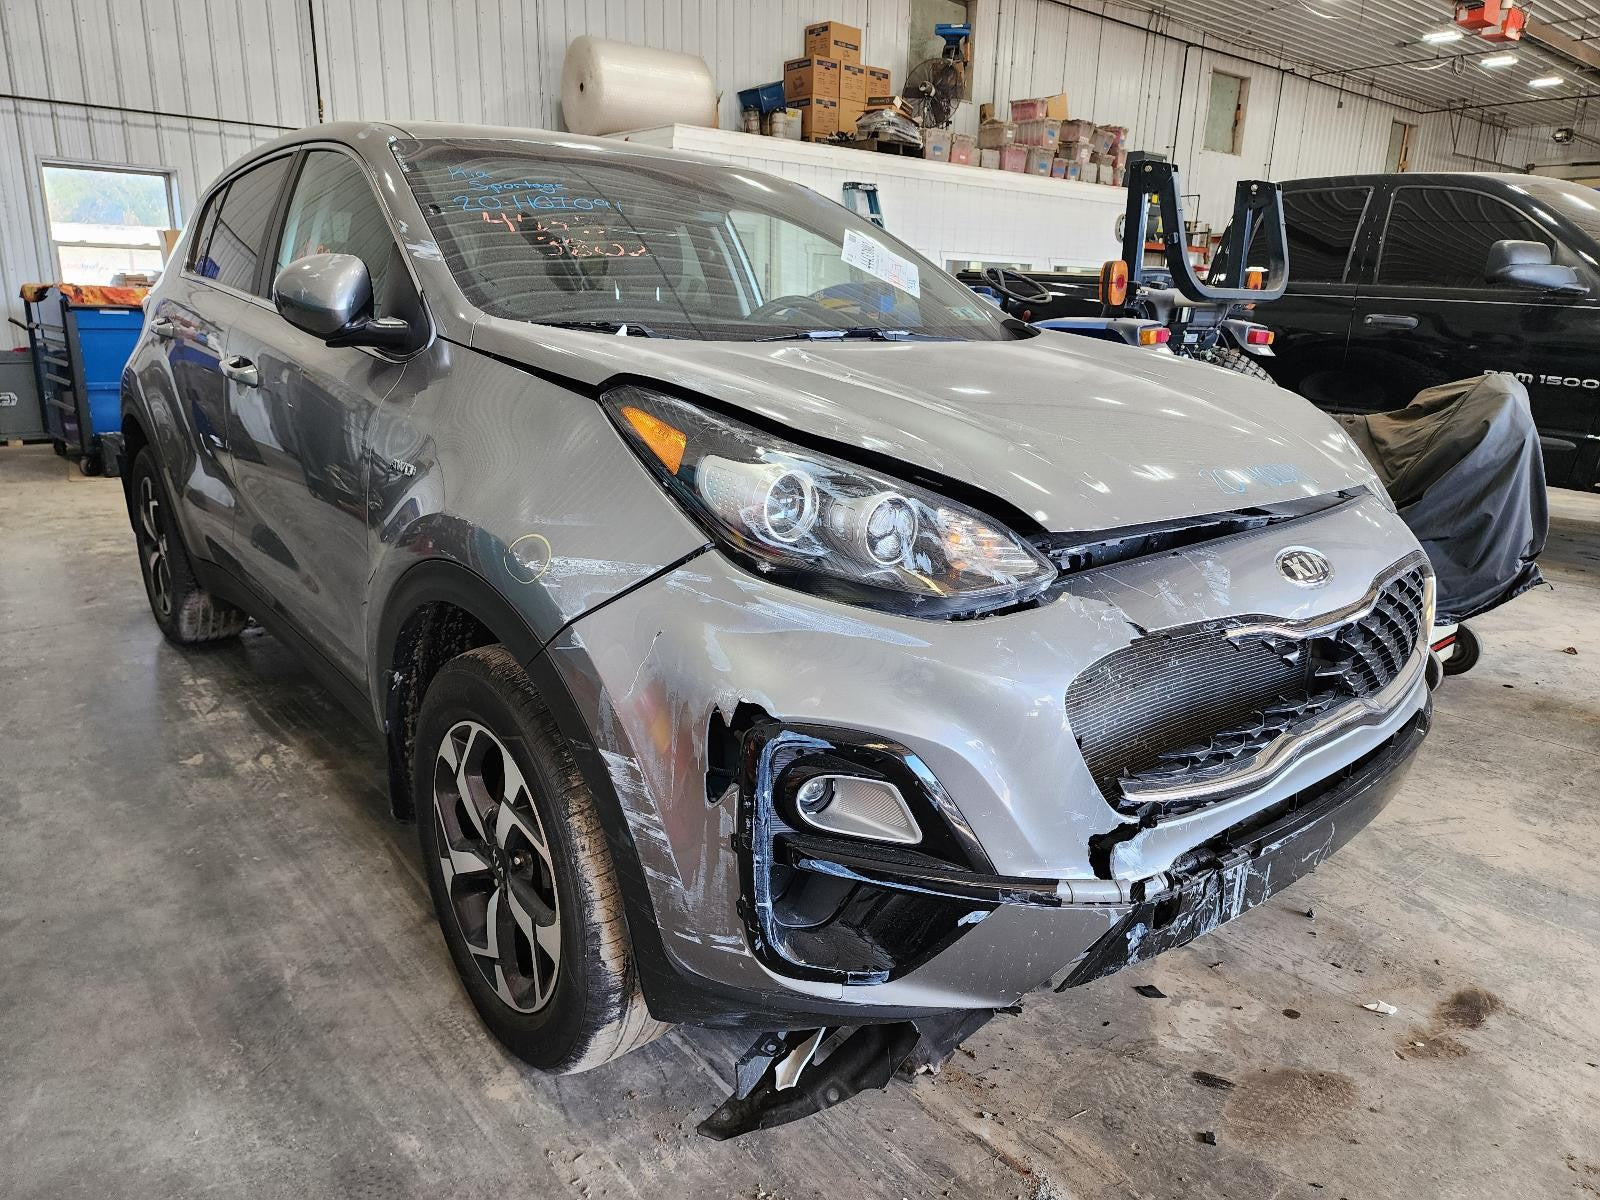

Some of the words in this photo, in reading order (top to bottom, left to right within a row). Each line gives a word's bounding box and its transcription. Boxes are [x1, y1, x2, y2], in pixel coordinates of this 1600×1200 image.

[447, 165, 493, 180] Kia
[1539, 374, 1600, 389] 1500
[1284, 551, 1330, 580] KIA
